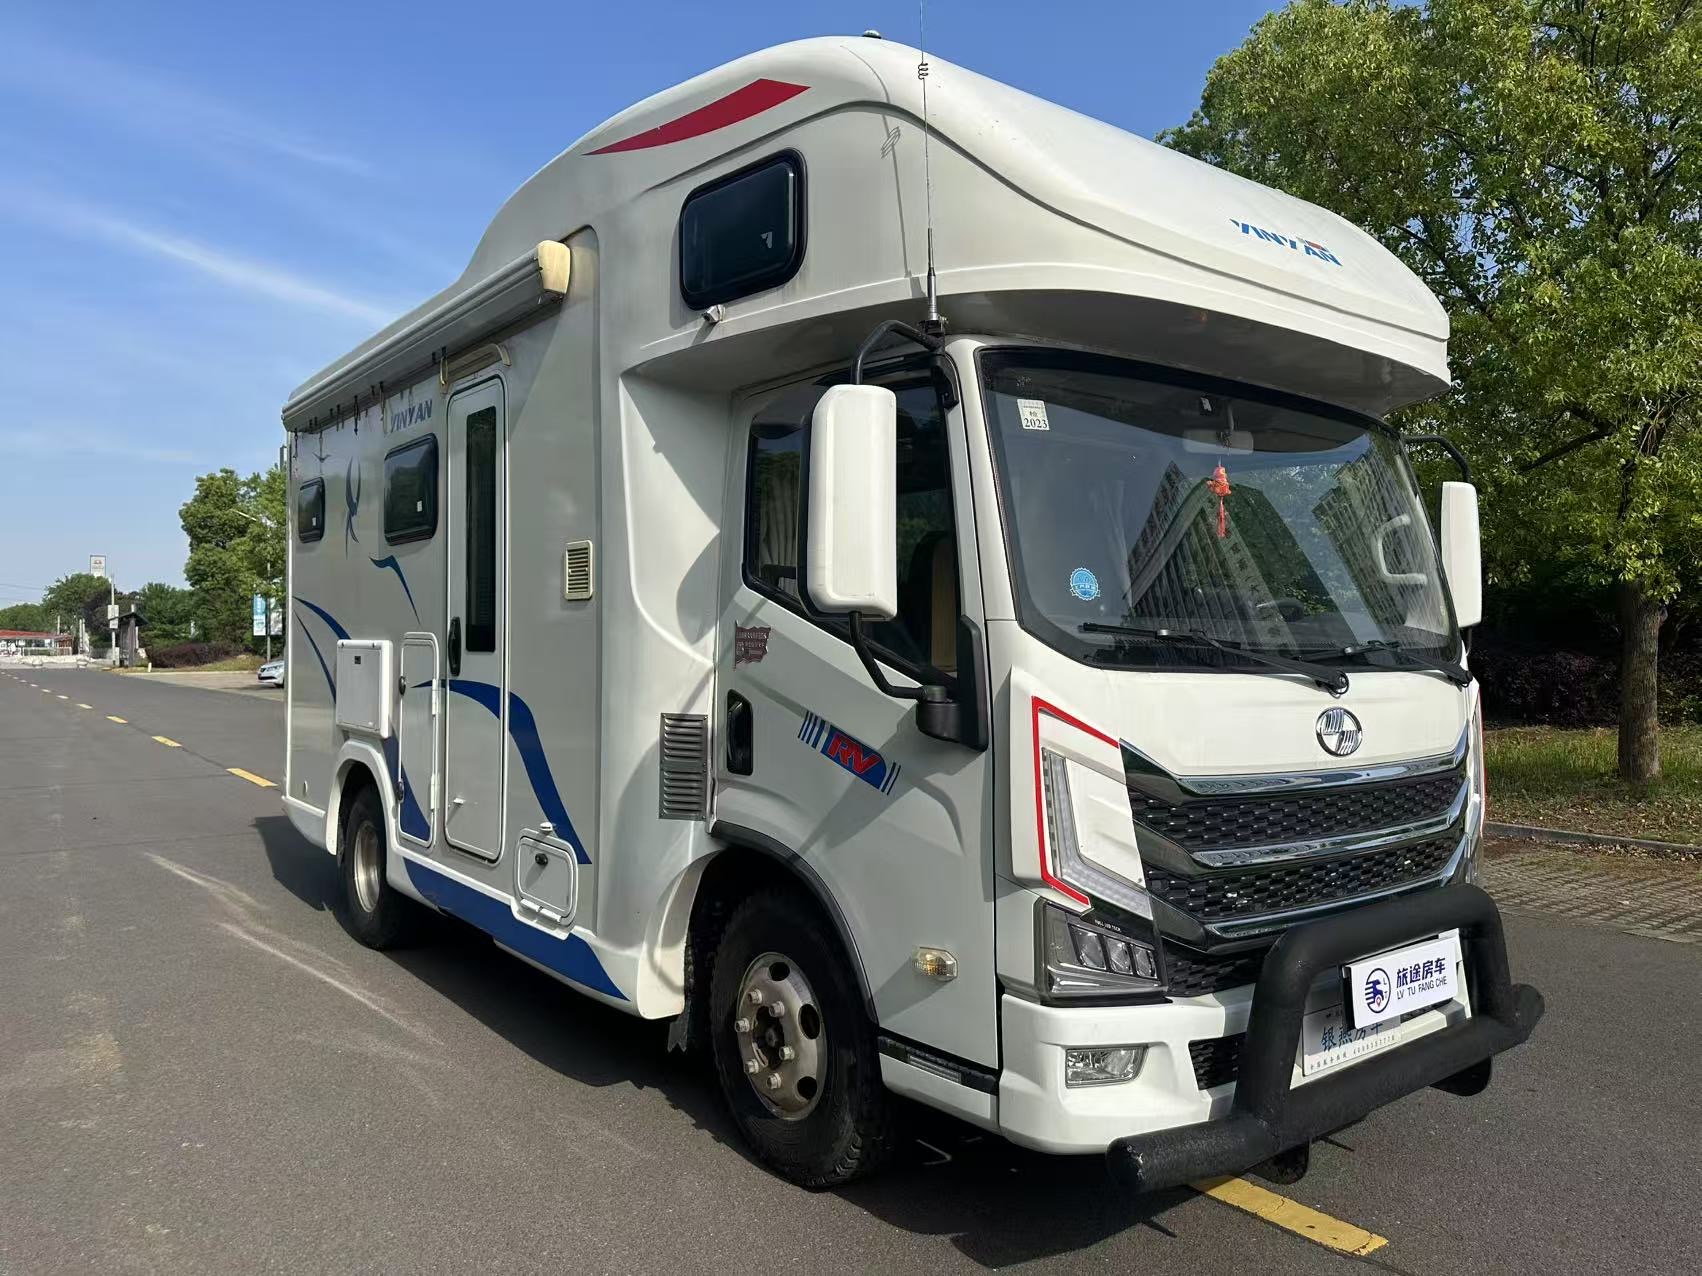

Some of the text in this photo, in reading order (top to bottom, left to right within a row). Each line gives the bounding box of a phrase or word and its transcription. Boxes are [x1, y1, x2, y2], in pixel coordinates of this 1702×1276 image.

[1229, 218, 1343, 266] YINYAN
[390, 399, 433, 433] YINYAN
[1024, 418, 1048, 429] 2023
[827, 731, 881, 774] RV
[1396, 957, 1446, 988] 旅途房车
[1396, 976, 1448, 1000] LV TU FANG CHE
